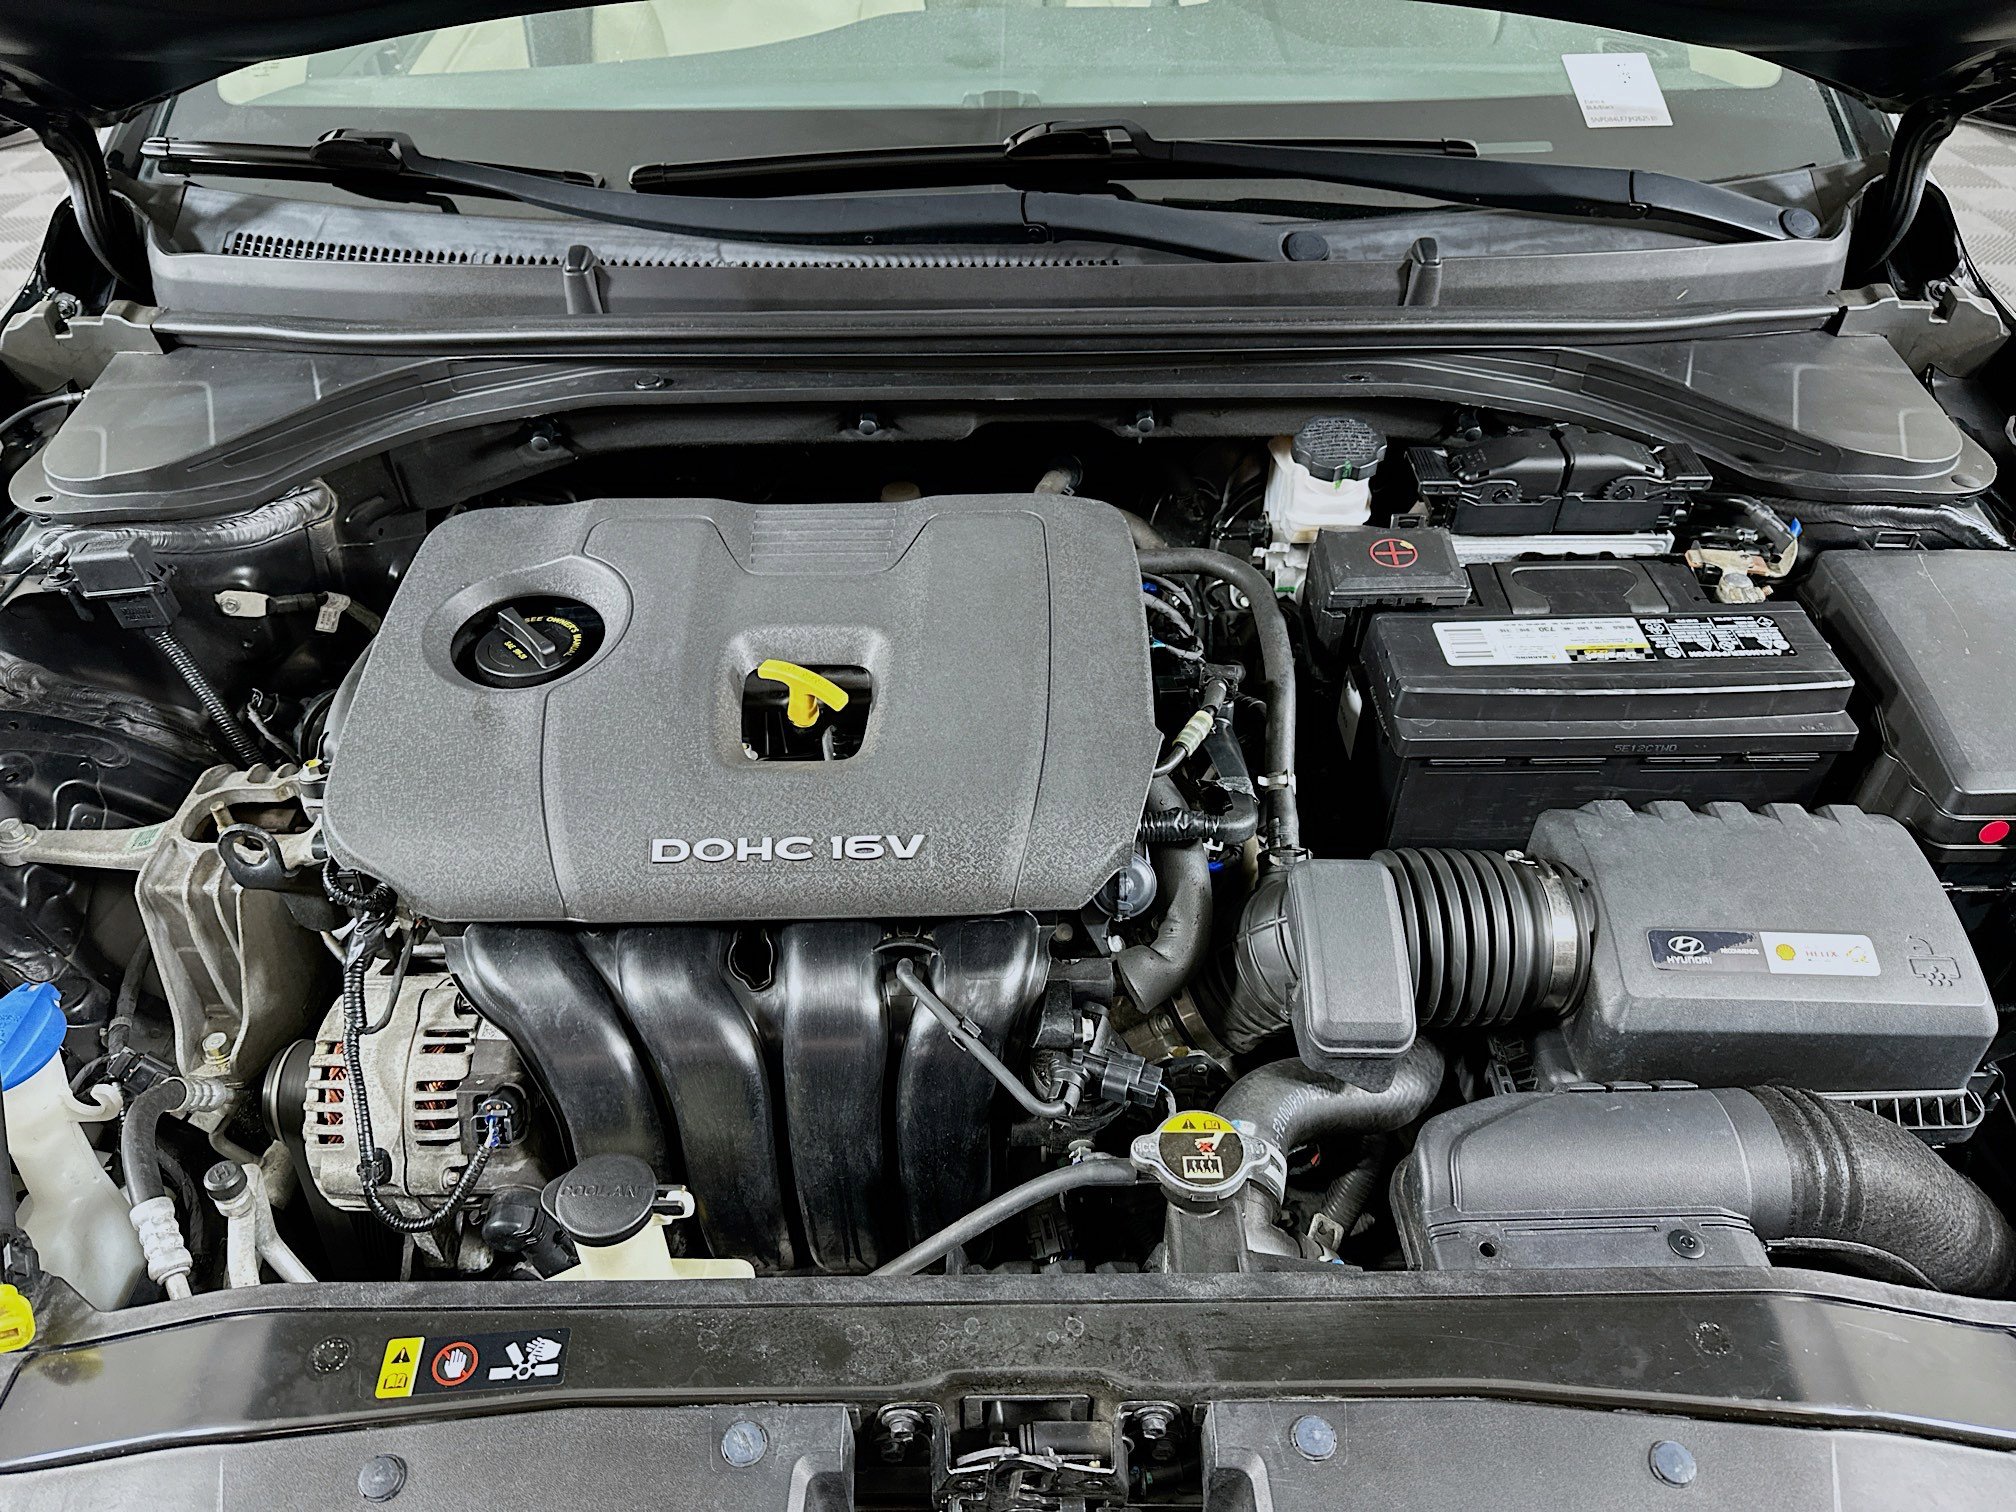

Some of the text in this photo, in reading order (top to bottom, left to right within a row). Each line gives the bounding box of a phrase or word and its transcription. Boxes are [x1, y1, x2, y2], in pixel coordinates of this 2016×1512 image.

[524, 616, 582, 657] SEE OWNER'S MANUAL
[652, 834, 926, 862] DOHC 16V
[1666, 955, 1713, 965] HYUNDAI
[1134, 1142, 1157, 1153] HCC
[559, 1184, 651, 1199] COOLANT
